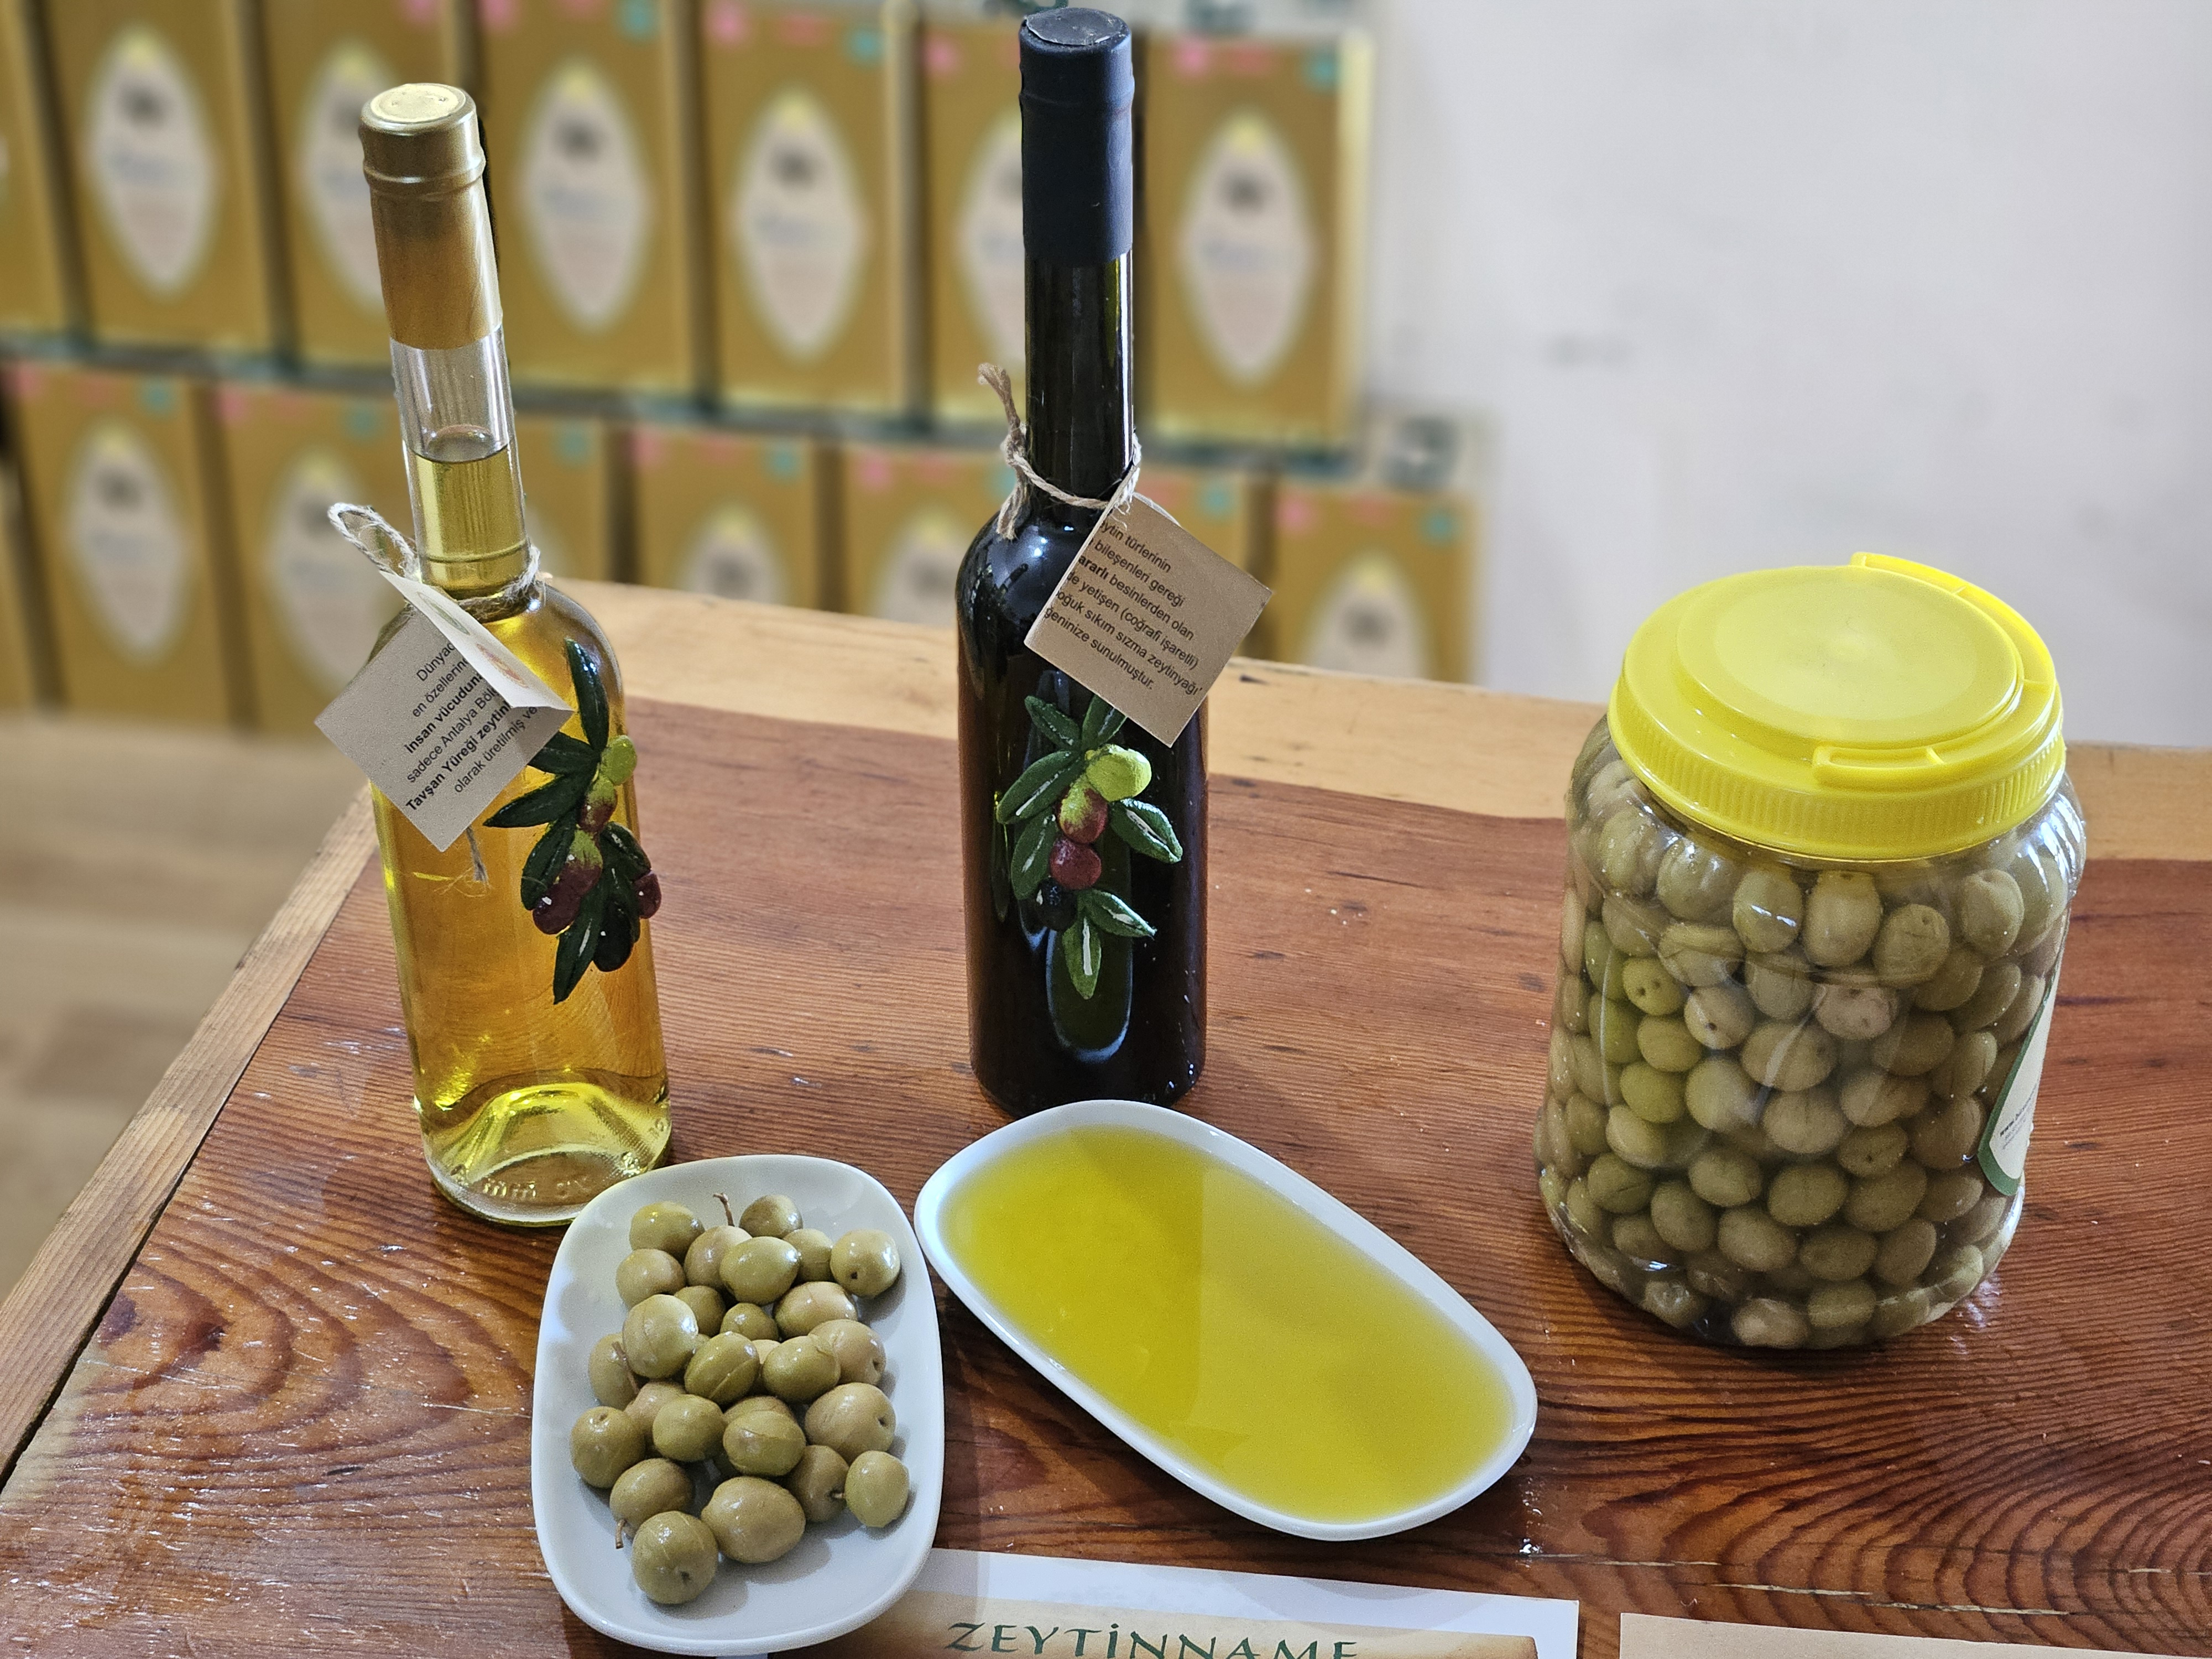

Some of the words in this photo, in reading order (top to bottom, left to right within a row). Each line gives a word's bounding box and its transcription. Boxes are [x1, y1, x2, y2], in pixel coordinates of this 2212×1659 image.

[1094, 540, 1149, 582] bileşenleri
[1149, 580, 1183, 607] gereği
[1125, 536, 1171, 572] türlerinin
[1056, 591, 1084, 614] oğuk
[1085, 610, 1115, 634] sıkım
[1116, 632, 1147, 658] sızma
[1079, 582, 1119, 612] yetişen
[1109, 574, 1170, 623] besinlerden
[1172, 621, 1193, 640] olan
[1091, 639, 1154, 690] sunulmuştur.
[413, 703, 427, 717] en
[405, 774, 445, 810] Tavşan
[441, 735, 478, 772] Yüreği
[408, 746, 442, 782] sadece
[441, 709, 478, 747] Antalya
[455, 760, 486, 792] olarak
[483, 719, 525, 761] üretilmiş
